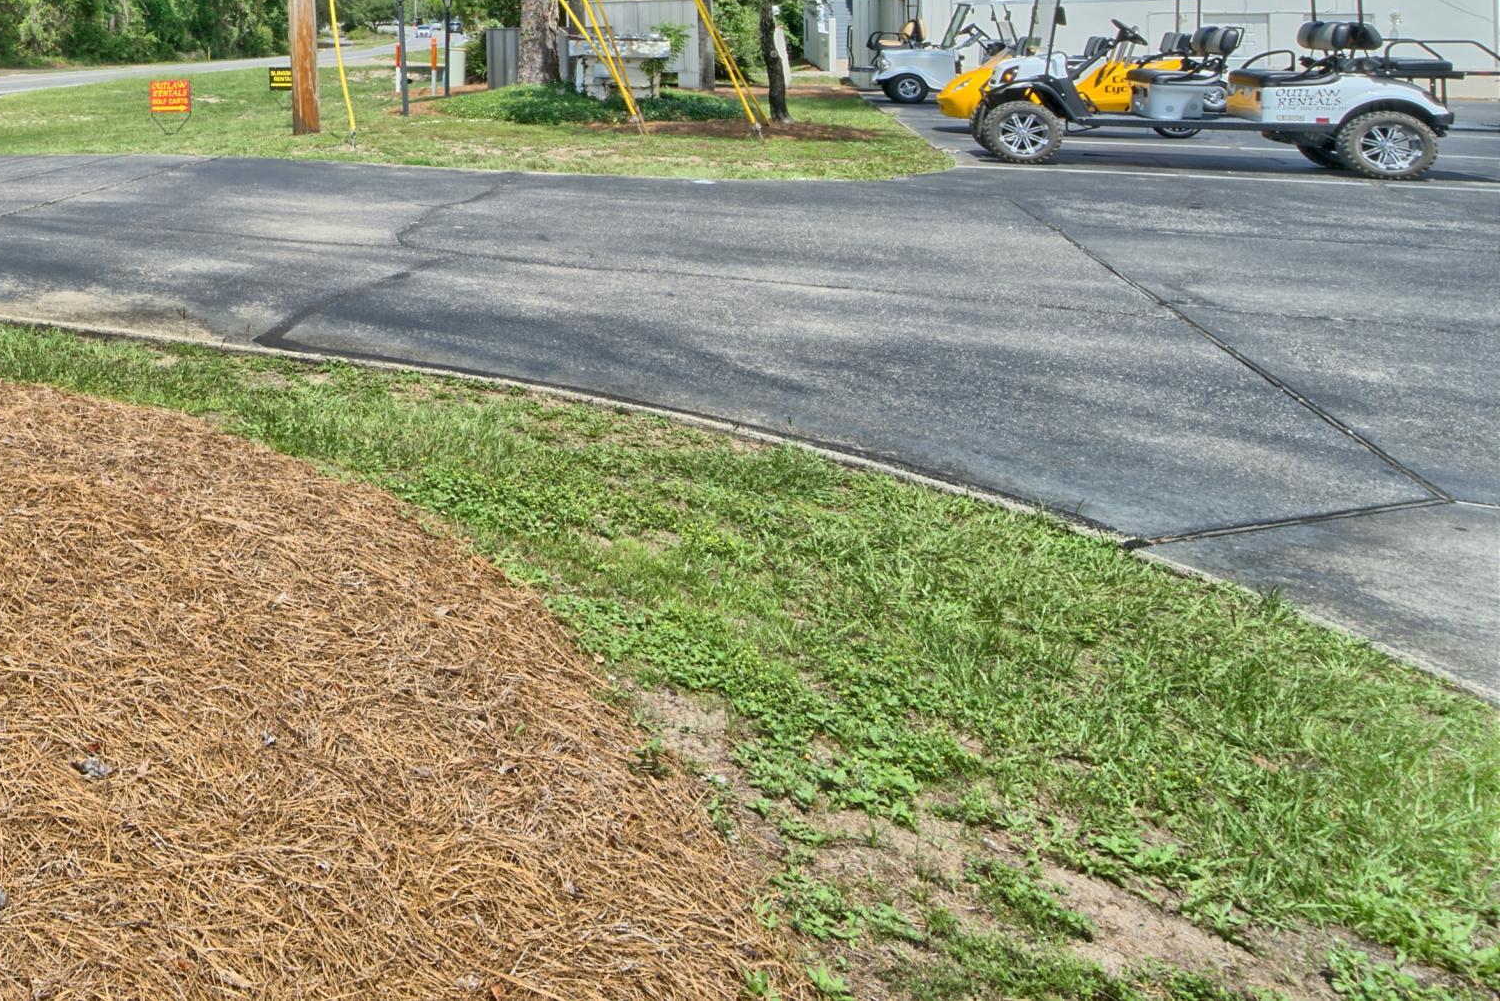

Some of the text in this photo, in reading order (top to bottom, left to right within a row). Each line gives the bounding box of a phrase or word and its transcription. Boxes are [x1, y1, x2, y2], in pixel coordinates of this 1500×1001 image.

[151, 80, 187, 89] OUTLAW
[152, 89, 187, 97] RENTALS
[1276, 88, 1341, 97] OUTLAW
[1277, 97, 1342, 107] RENTALS
